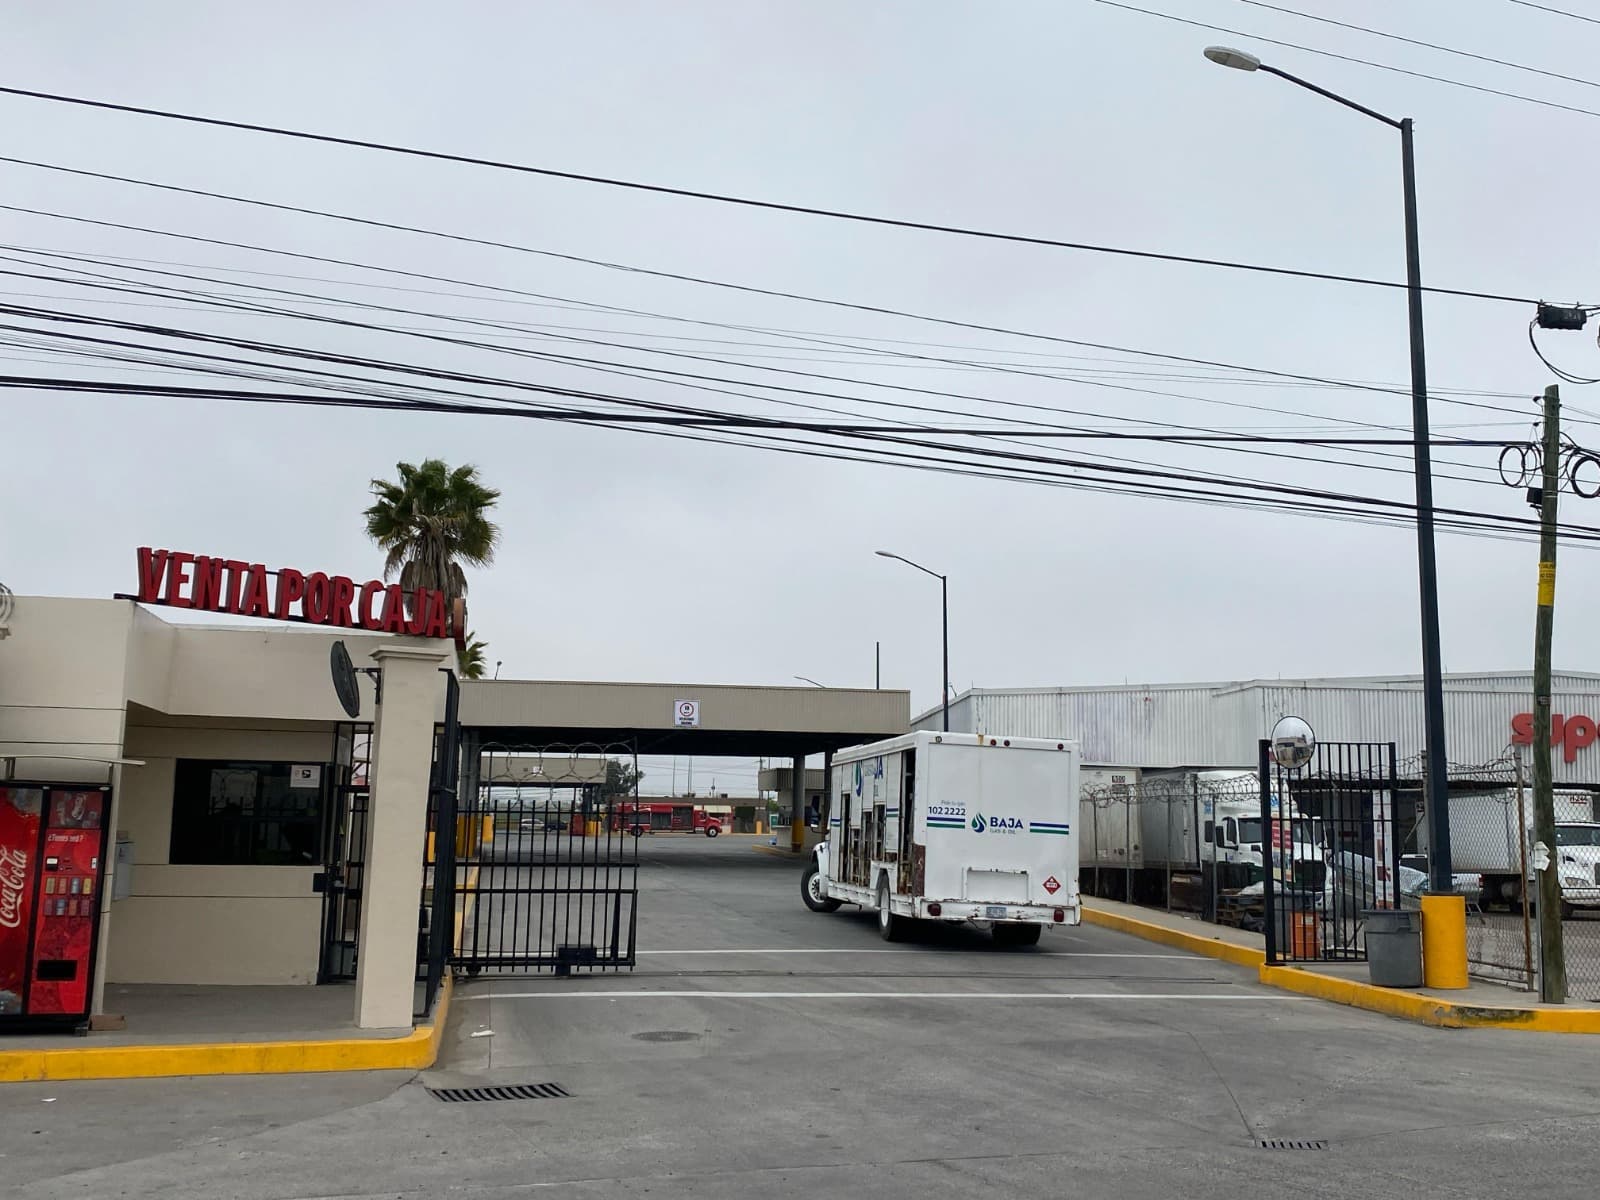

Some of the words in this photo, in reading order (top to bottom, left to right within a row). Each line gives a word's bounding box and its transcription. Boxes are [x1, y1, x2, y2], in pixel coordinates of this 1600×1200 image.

[137, 547, 269, 617] VENTA
[277, 568, 354, 628] POR
[358, 580, 447, 638] CAJA
[928, 806, 943, 815] 102
[944, 807, 966, 816] 2222
[990, 816, 1024, 829] BAJA
